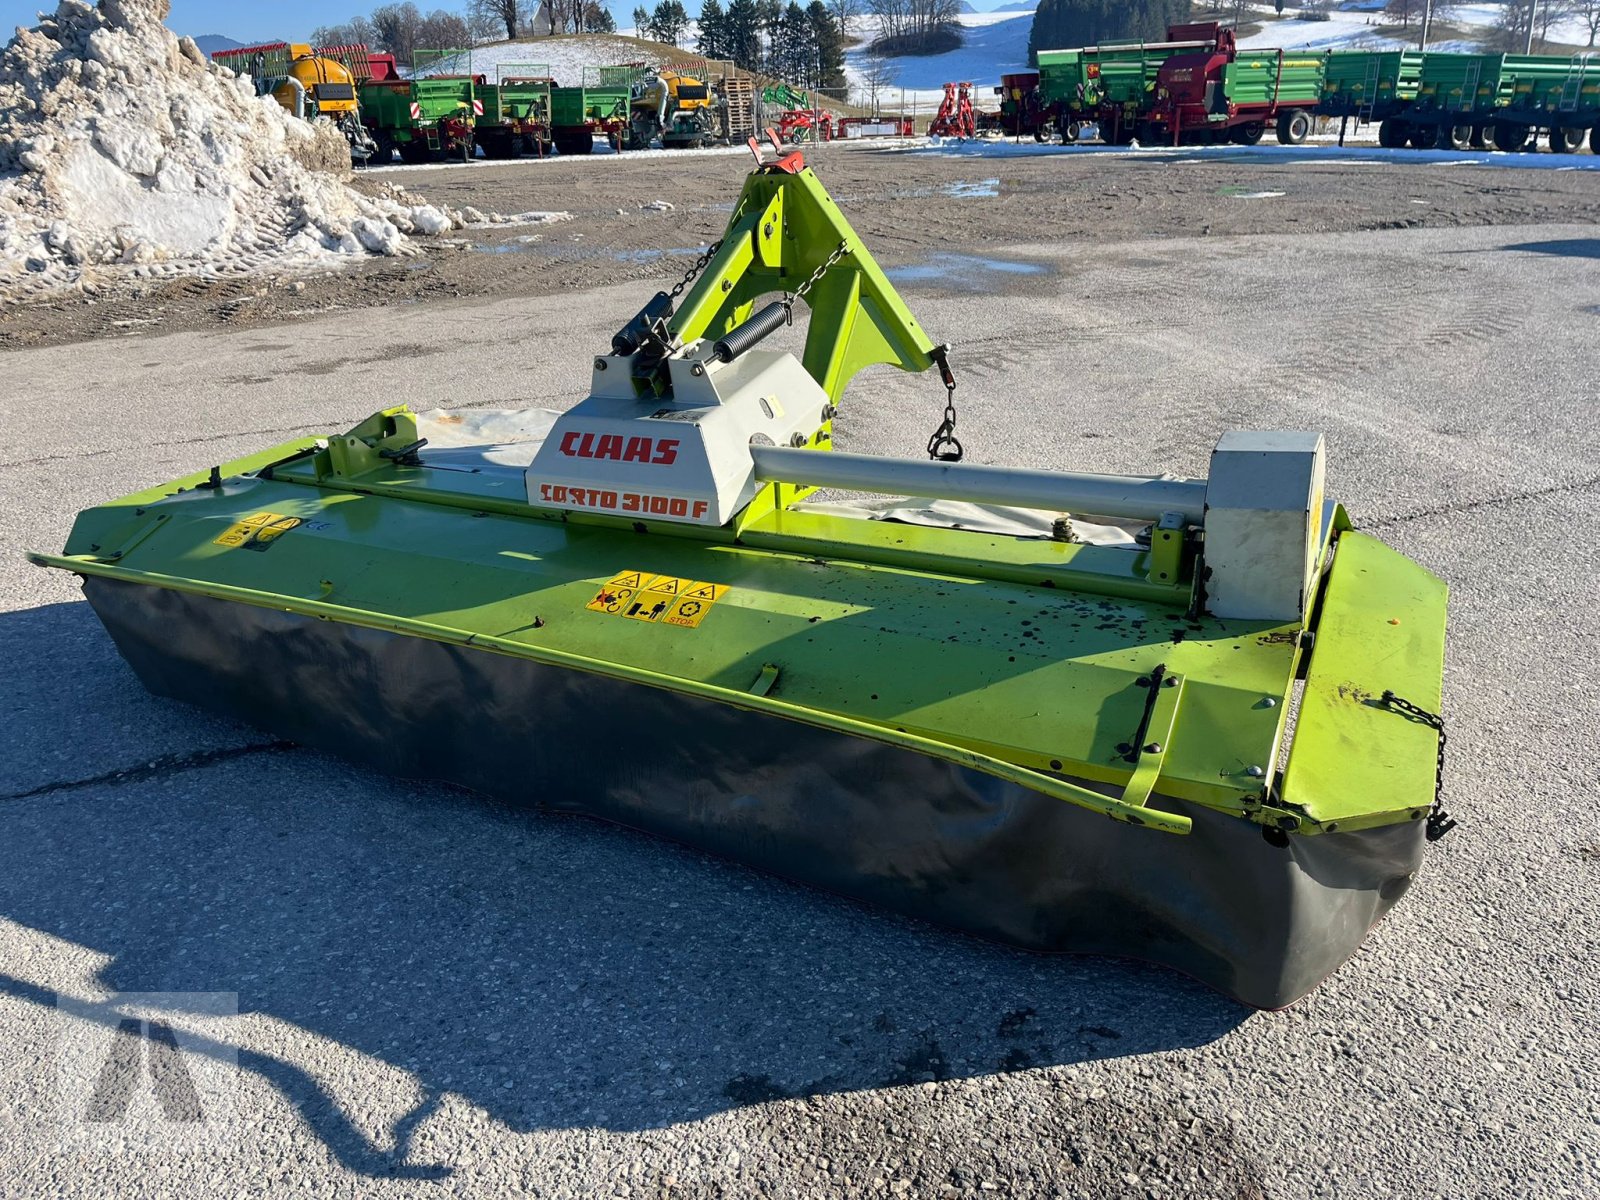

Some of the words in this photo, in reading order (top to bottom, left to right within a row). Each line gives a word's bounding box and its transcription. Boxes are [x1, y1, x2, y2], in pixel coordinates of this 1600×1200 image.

[559, 432, 681, 465] CLAAS
[622, 493, 688, 517] 3100
[692, 501, 708, 519] F
[669, 617, 694, 625] STOP
